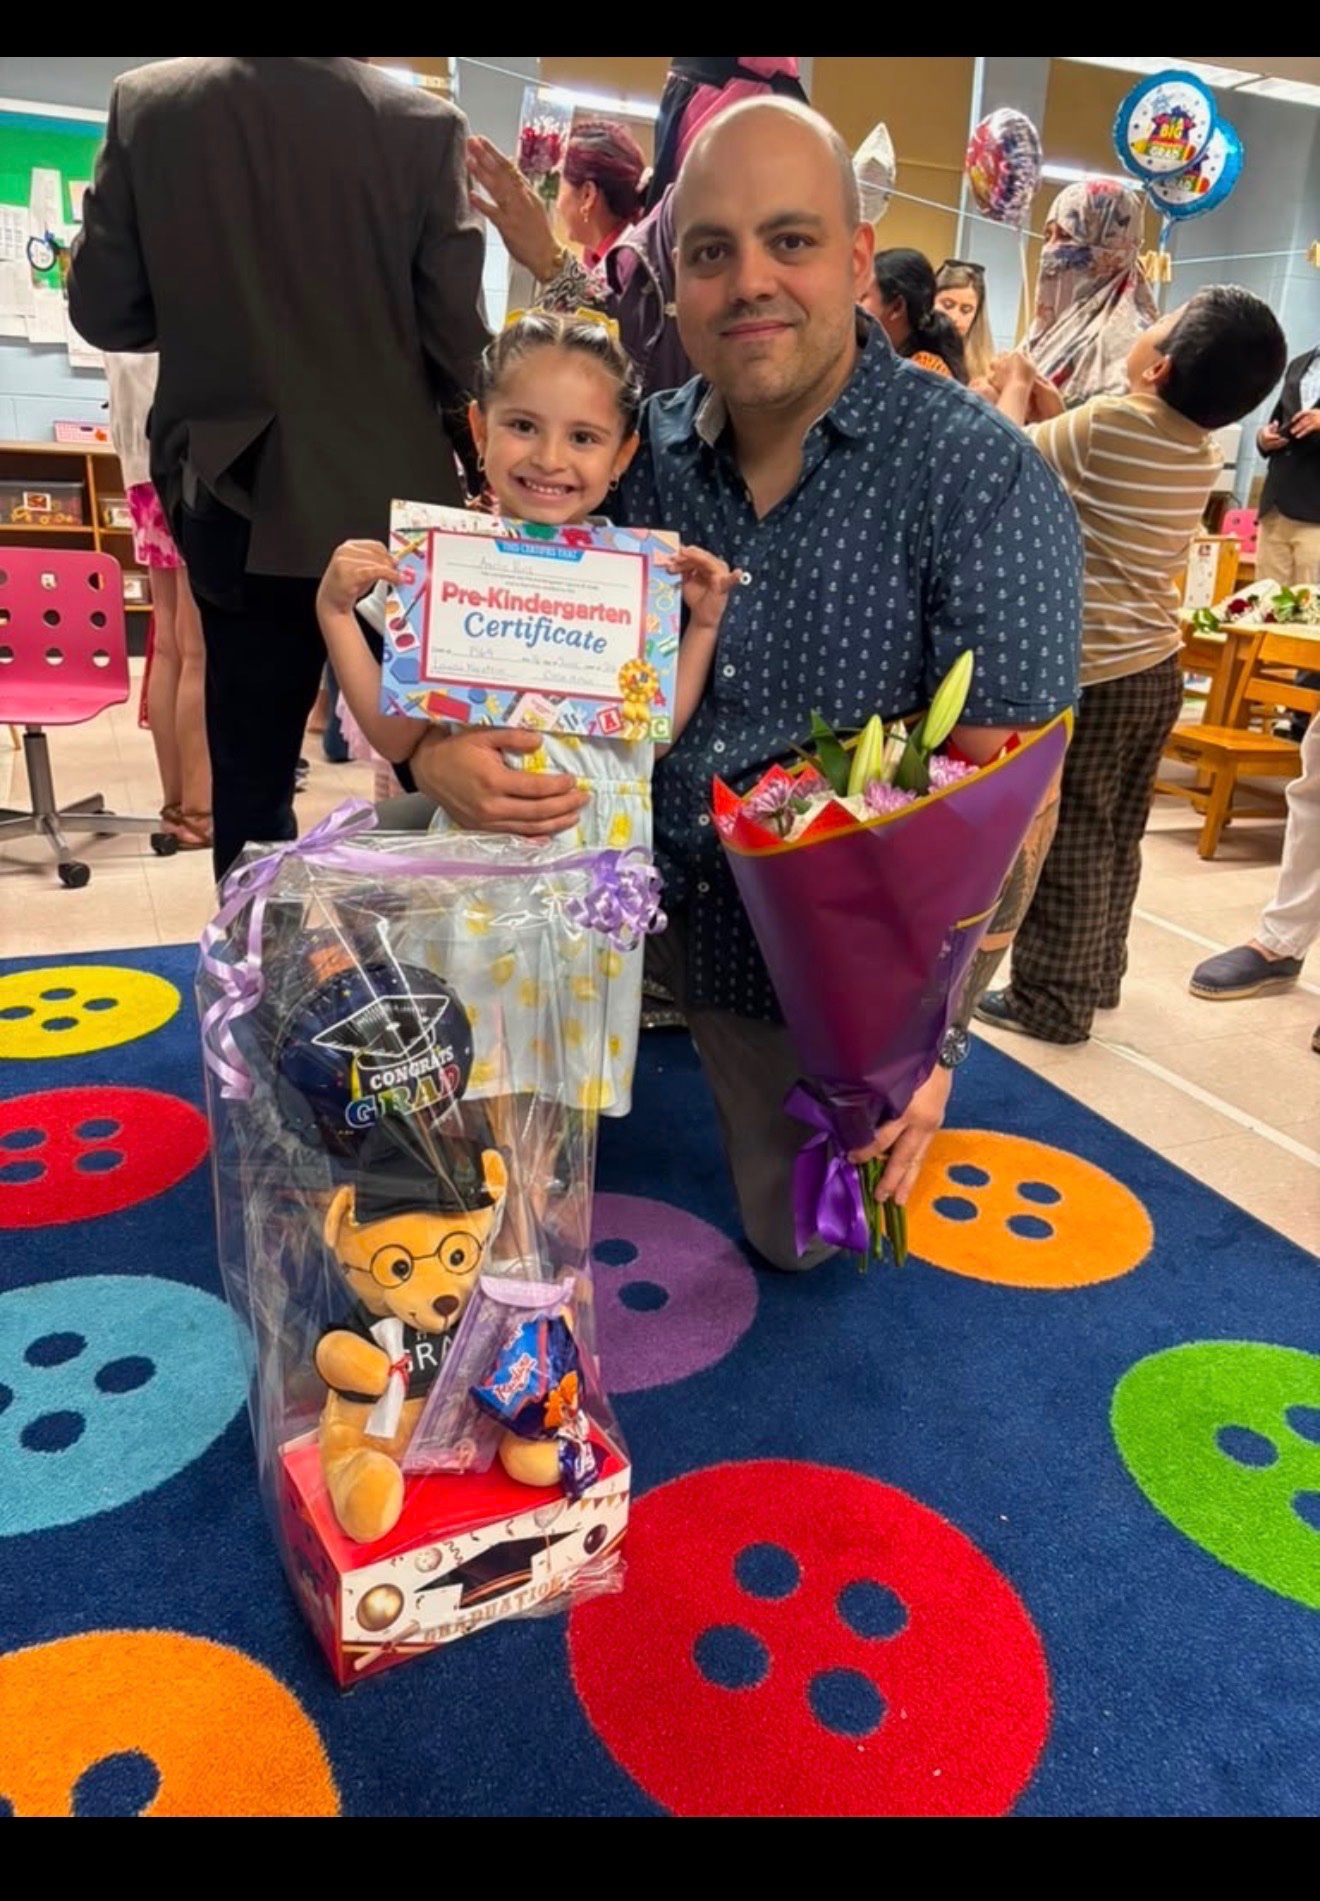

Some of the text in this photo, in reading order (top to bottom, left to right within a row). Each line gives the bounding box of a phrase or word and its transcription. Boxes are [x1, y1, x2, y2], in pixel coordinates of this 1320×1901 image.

[1149, 148, 1181, 161] GRAD
[441, 581, 631, 625] Pre-Kindergarten
[464, 611, 607, 654] Certificate
[370, 1046, 455, 1090] CONGRATS
[345, 1063, 460, 1128] GRAD
[423, 1575, 563, 1643] GRADUATION
